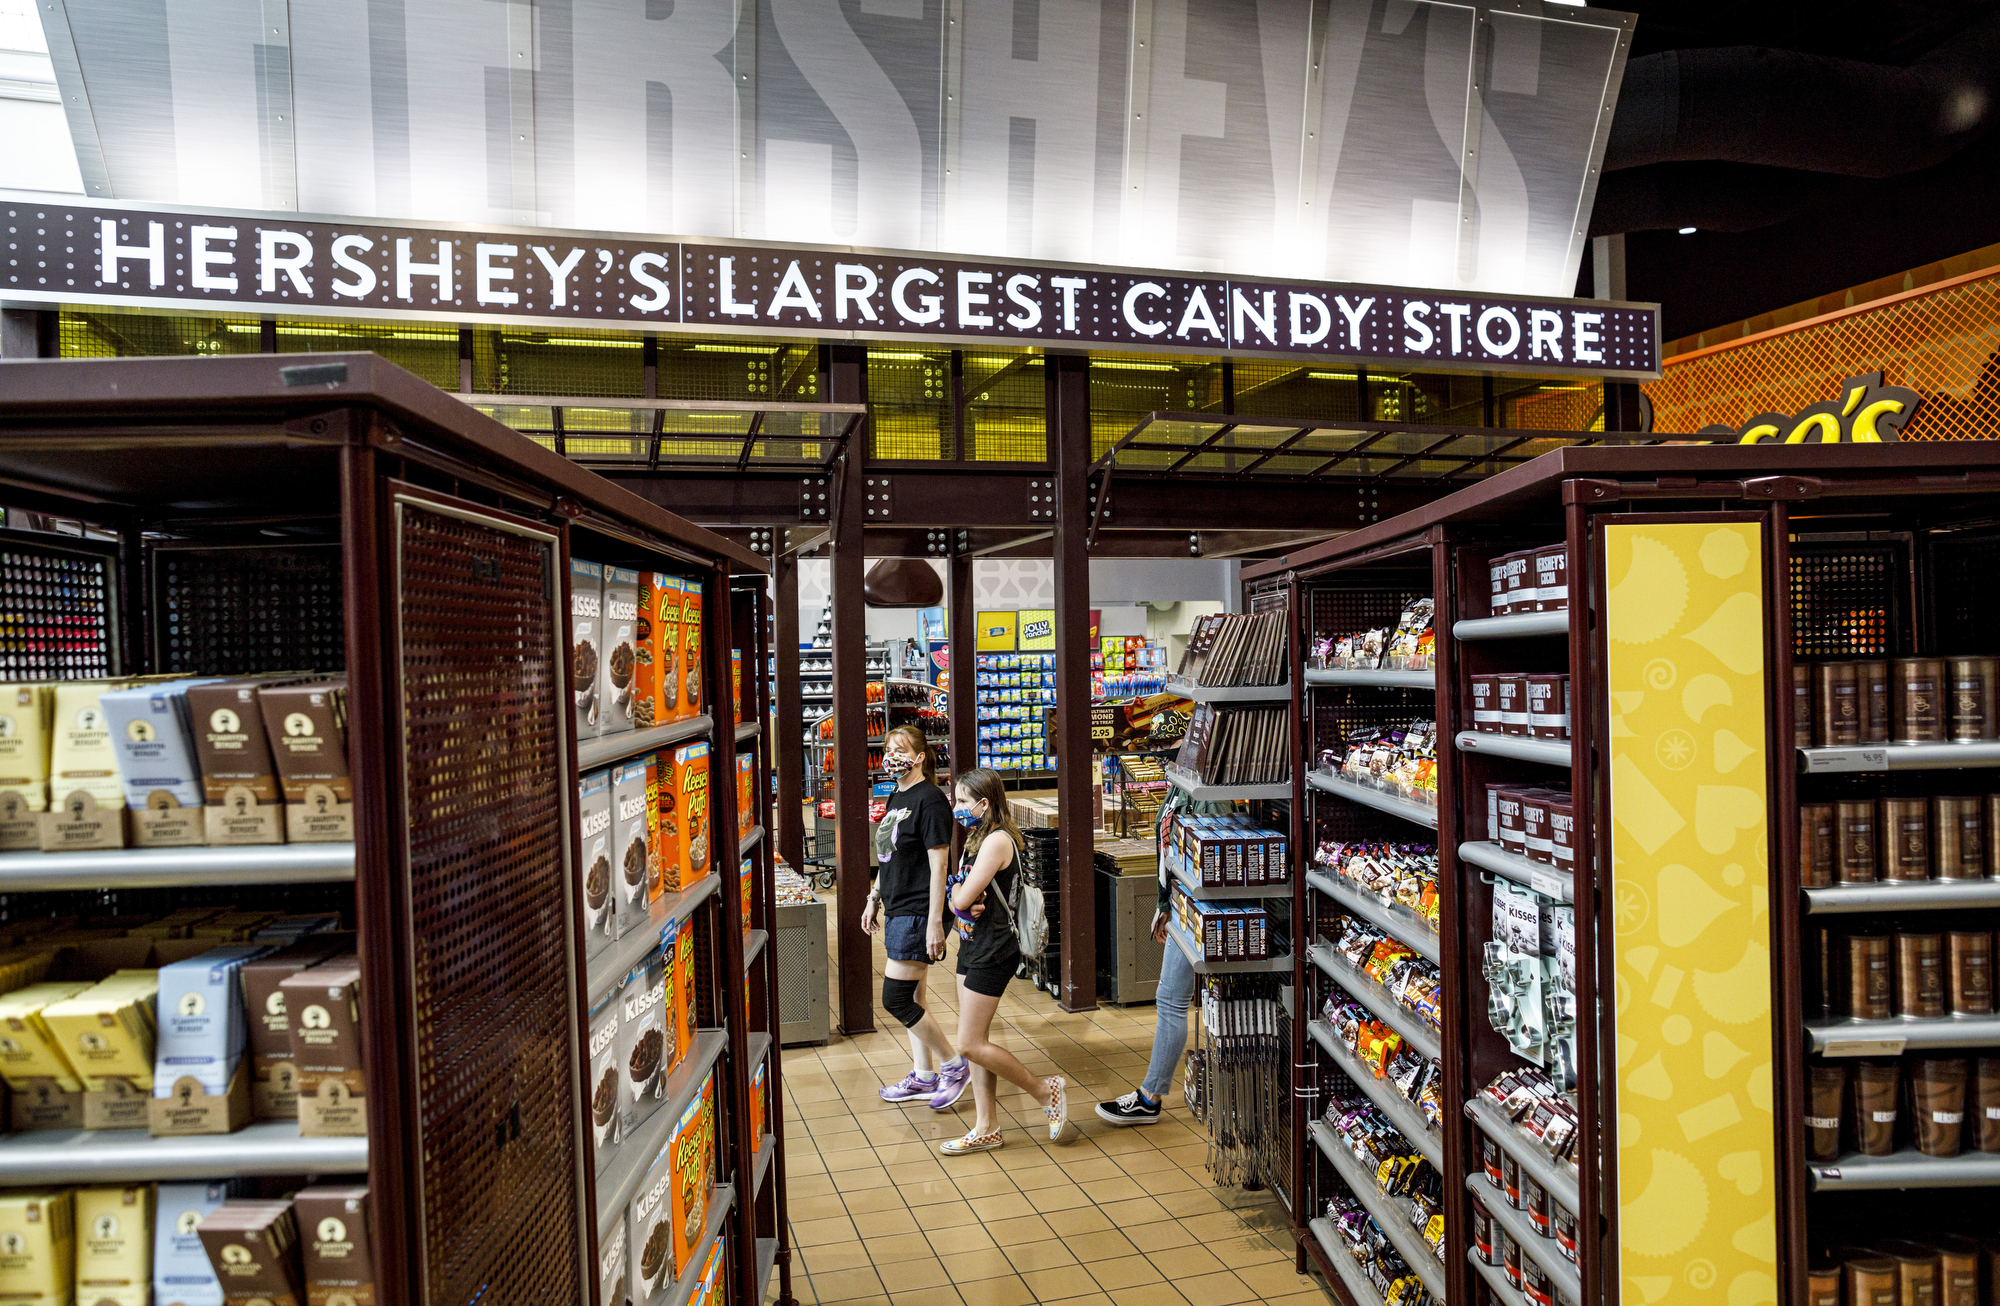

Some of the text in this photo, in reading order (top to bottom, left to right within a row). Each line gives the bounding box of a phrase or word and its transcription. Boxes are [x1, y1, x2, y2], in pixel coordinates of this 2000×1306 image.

[101, 218, 1602, 362] HERSHEY'S LARGEST CANDY STORE
[1024, 620, 1049, 634] JOLLY
